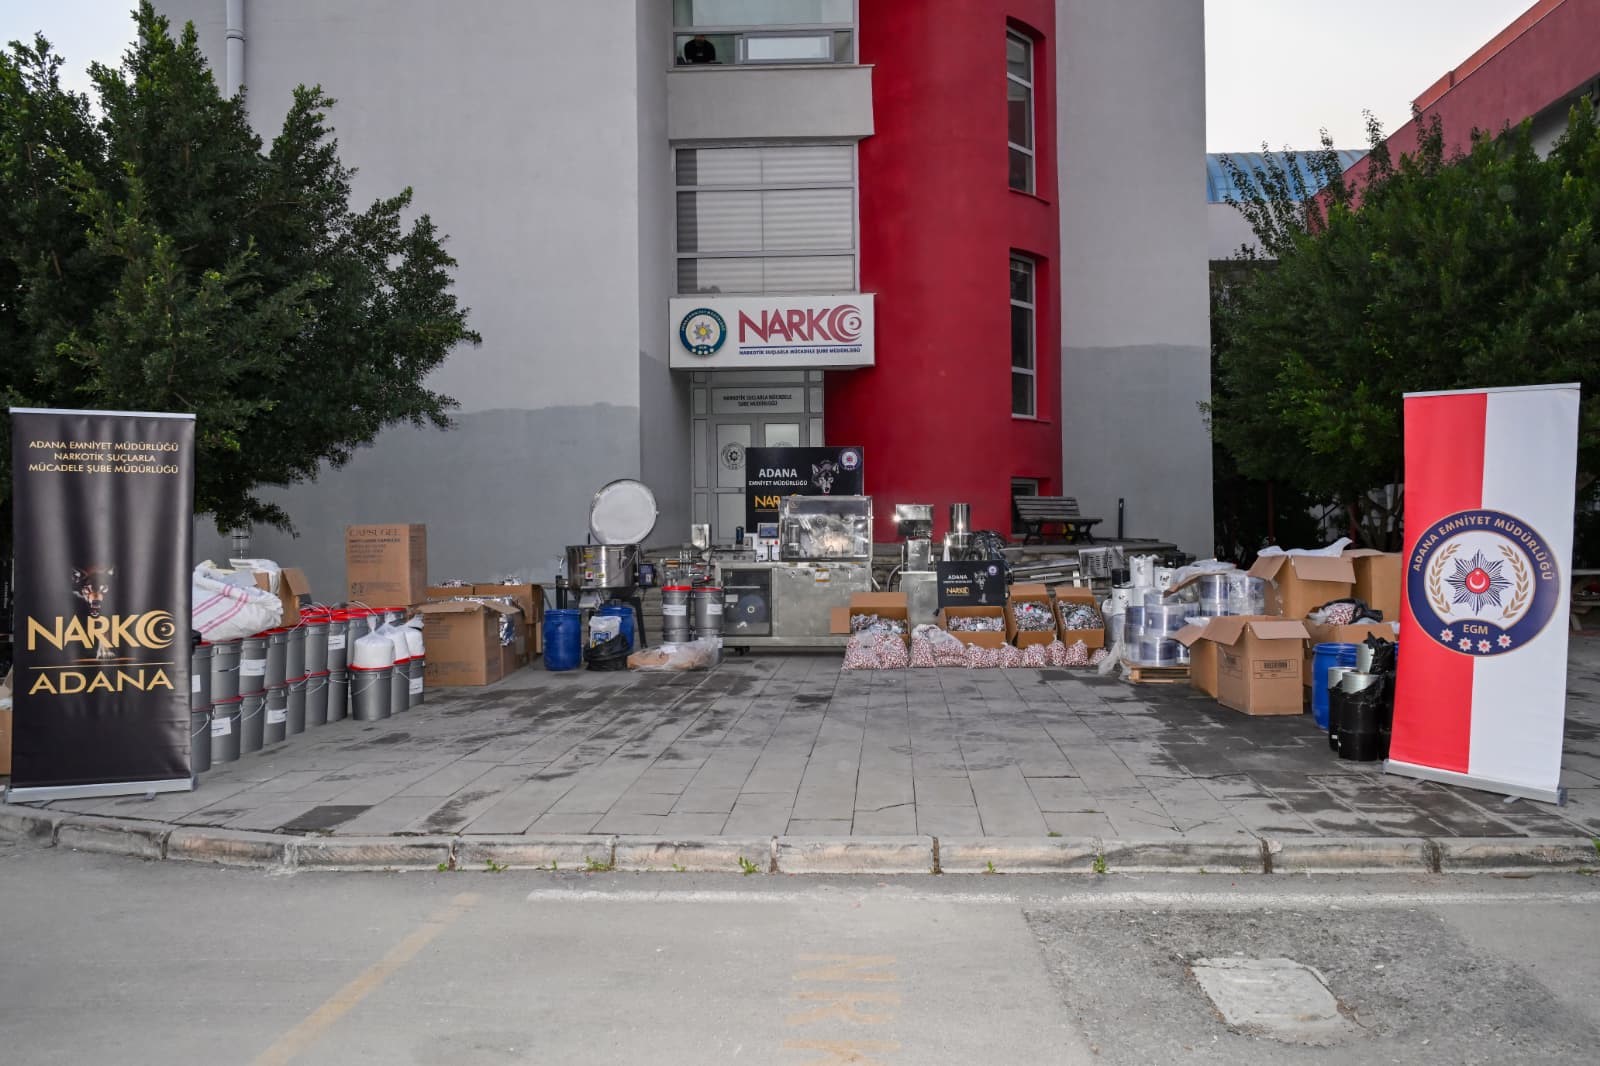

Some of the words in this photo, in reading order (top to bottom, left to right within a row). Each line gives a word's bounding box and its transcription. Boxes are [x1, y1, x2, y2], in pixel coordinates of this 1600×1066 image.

[29, 440, 66, 449] ADANA
[69, 440, 112, 450] EMNİYET
[115, 441, 179, 452] MÜDÜRLÜĞÜ
[54, 452, 104, 461] NARKOTİK
[107, 453, 156, 463] SUÇLARLA
[28, 462, 84, 472] MÜCADELE
[87, 464, 112, 474] ŞUBE
[114, 464, 179, 474] MÜDÜRLÜĞÜ
[758, 468, 798, 478] ADANA
[1412, 534, 1439, 572] ADANA
[1438, 514, 1492, 535] EMNİYET
[1494, 518, 1553, 580] MÜDÜRLÜĞÜ
[27, 610, 176, 651] NARKO
[1462, 623, 1489, 635] EGM
[28, 668, 175, 695] ADANA
